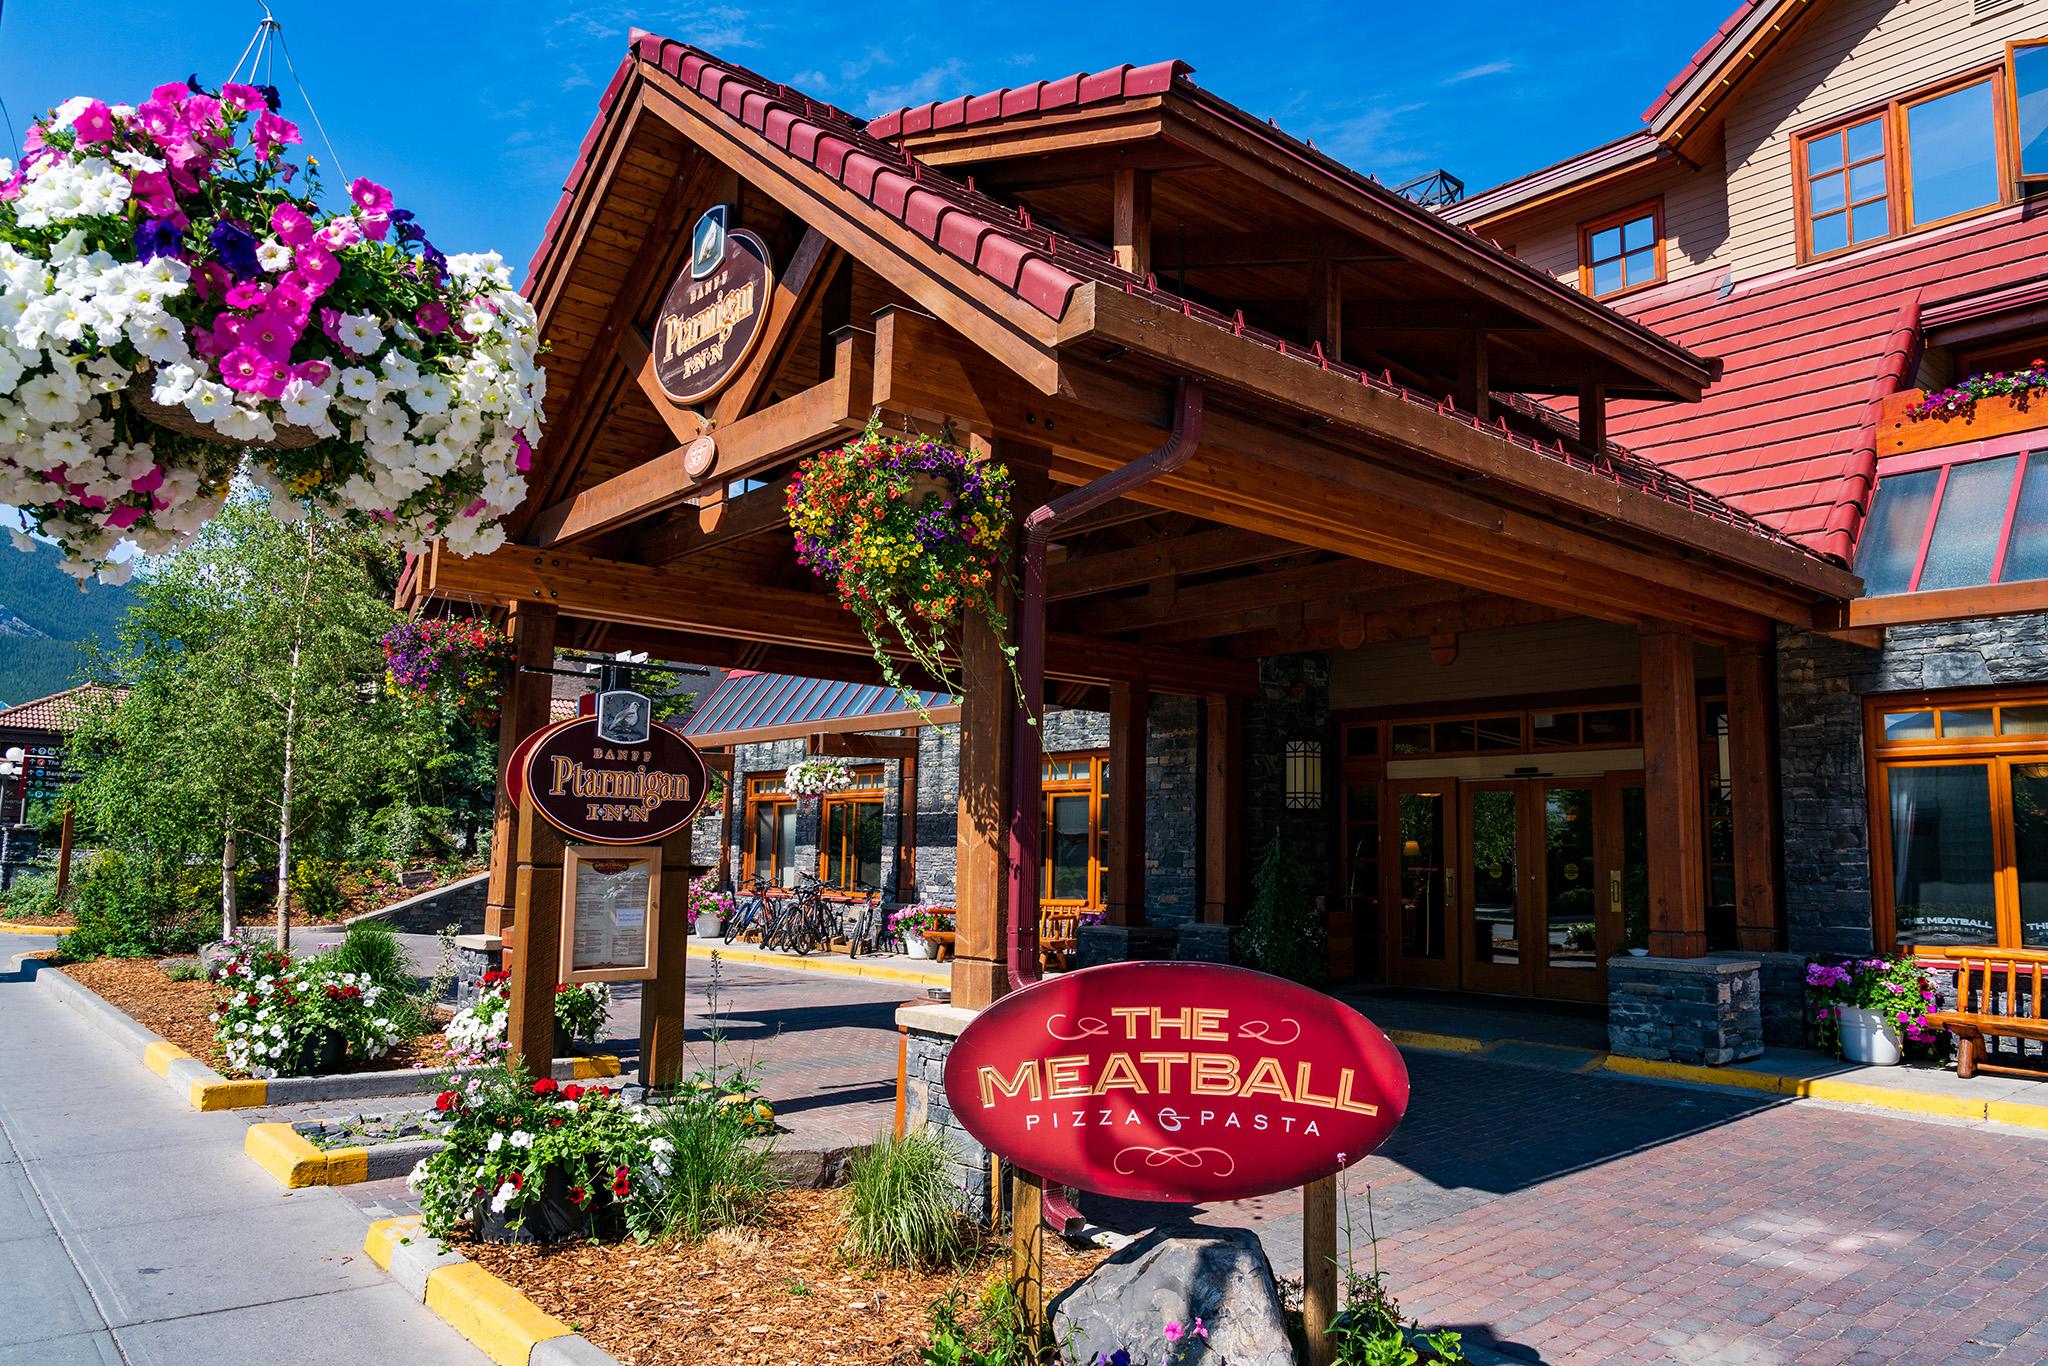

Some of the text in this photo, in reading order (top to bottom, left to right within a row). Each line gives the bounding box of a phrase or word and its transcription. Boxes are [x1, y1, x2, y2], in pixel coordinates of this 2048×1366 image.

[690, 271, 729, 304] BANFF
[663, 281, 754, 363] Ptarmigan
[593, 748, 652, 762] BANFF
[549, 755, 690, 810] Ptarmigan
[1927, 916, 1992, 929] MEATBALL
[1111, 1007, 1229, 1042] THE
[977, 1051, 1378, 1117] MEATBALL
[1026, 1110, 1142, 1131] PIZZA
[1200, 1111, 1320, 1137] PASTA
